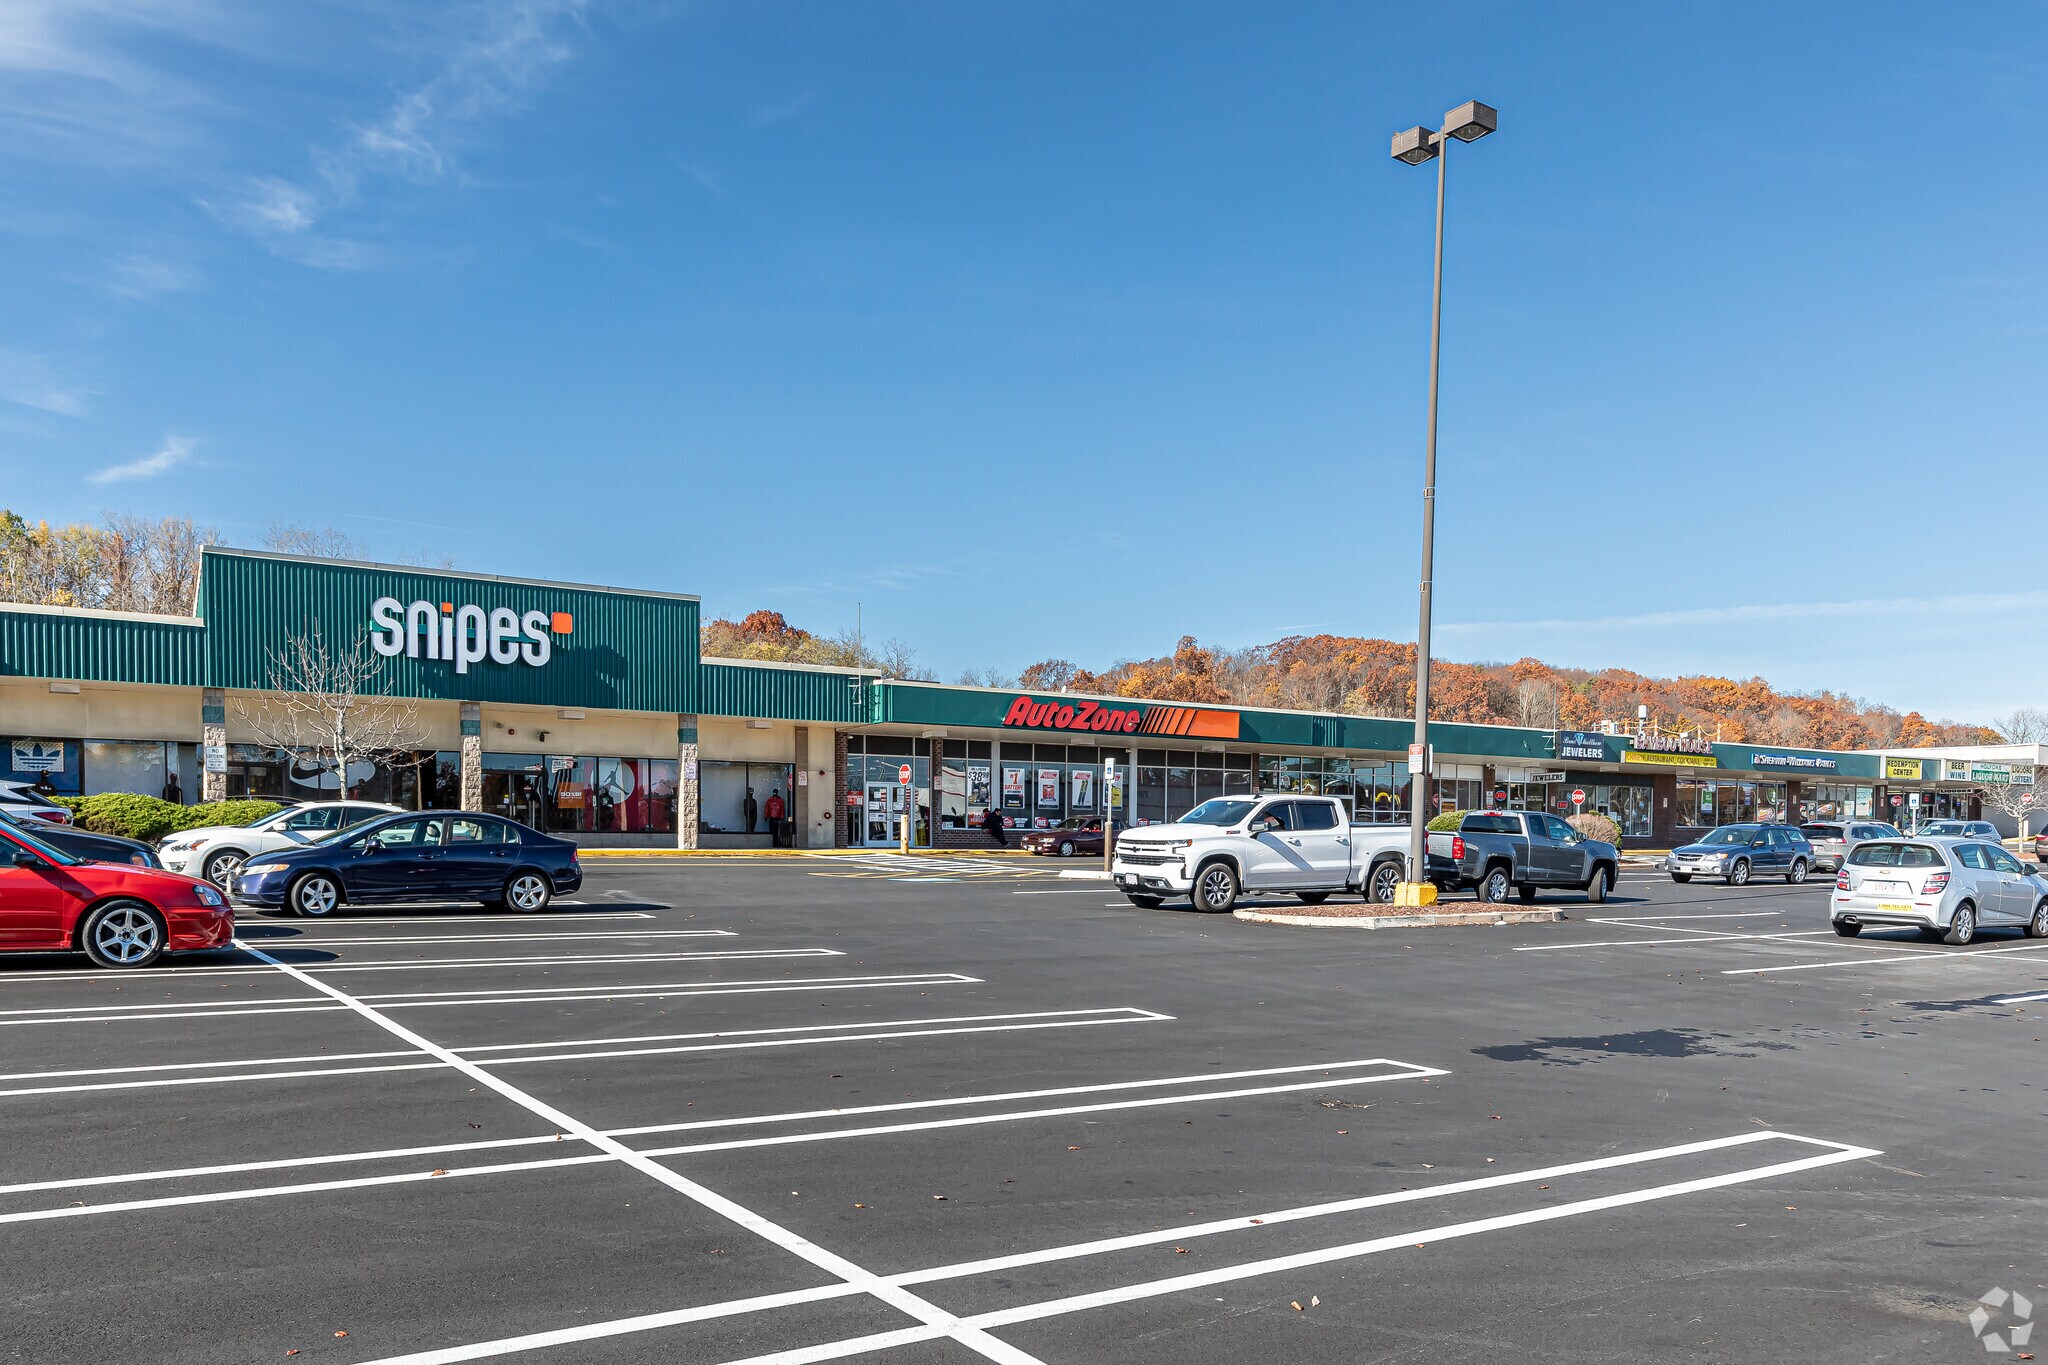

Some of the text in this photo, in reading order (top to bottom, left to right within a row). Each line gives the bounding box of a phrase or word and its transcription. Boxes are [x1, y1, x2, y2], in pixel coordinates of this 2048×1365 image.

[371, 597, 550, 674] snipes
[1003, 696, 1140, 732] AutoZone
[1635, 733, 1713, 754] BAMBOO HOUSE
[1561, 746, 1603, 759] JEWELERS
[1647, 754, 1674, 763] RESTAURANT
[1887, 760, 1919, 769] REDEMPTION
[1951, 761, 1965, 770] BEER
[1532, 774, 1563, 782] JEWELERS
[1950, 771, 1966, 780] WINE
[1972, 771, 1993, 782] LIQUOR
